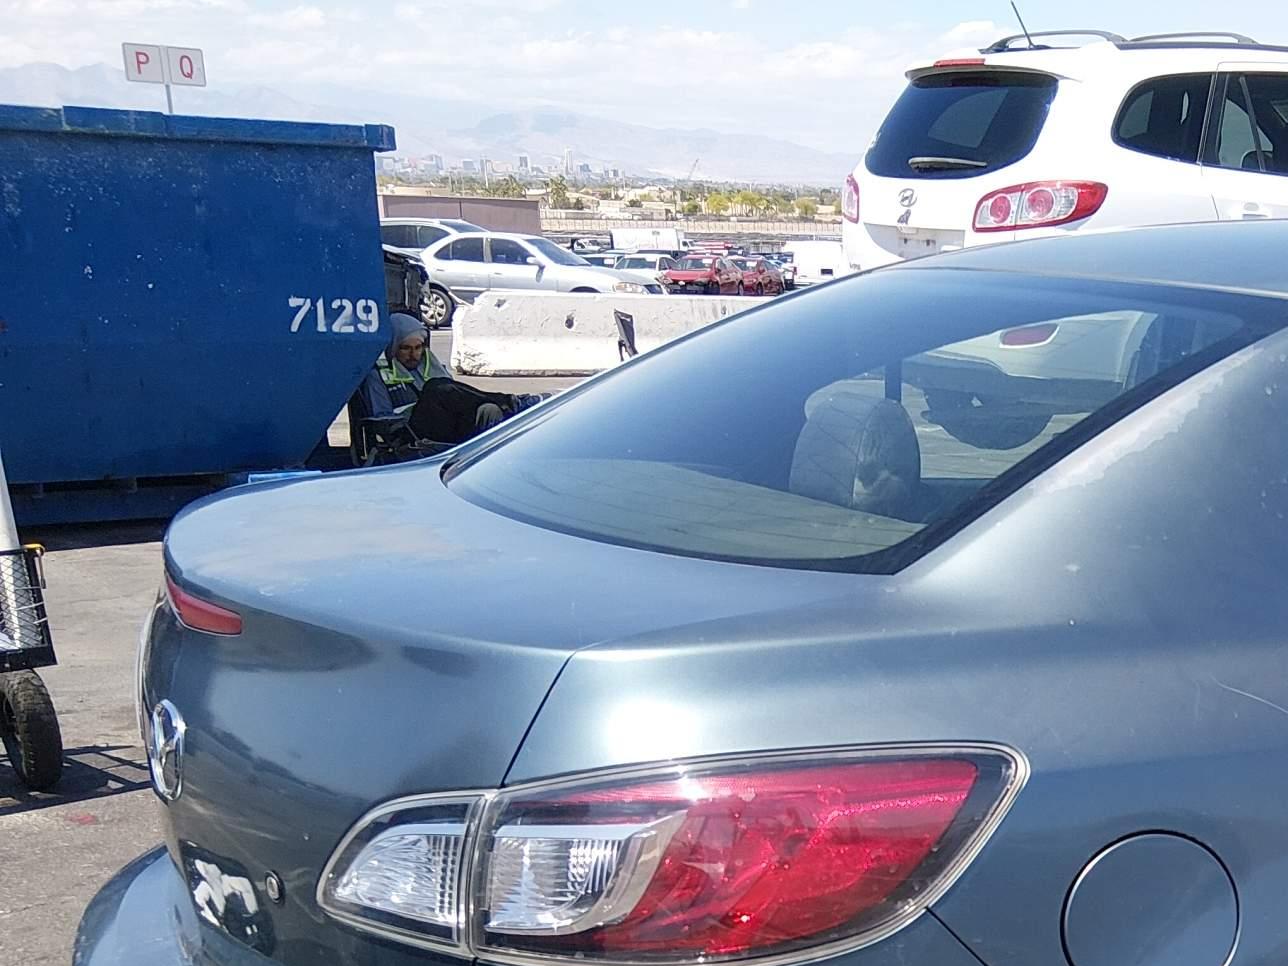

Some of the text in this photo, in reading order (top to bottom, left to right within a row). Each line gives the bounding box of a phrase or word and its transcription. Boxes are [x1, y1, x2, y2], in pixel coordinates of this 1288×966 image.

[135, 51, 149, 75] P
[180, 55, 193, 79] Q
[288, 296, 379, 333] 7129
